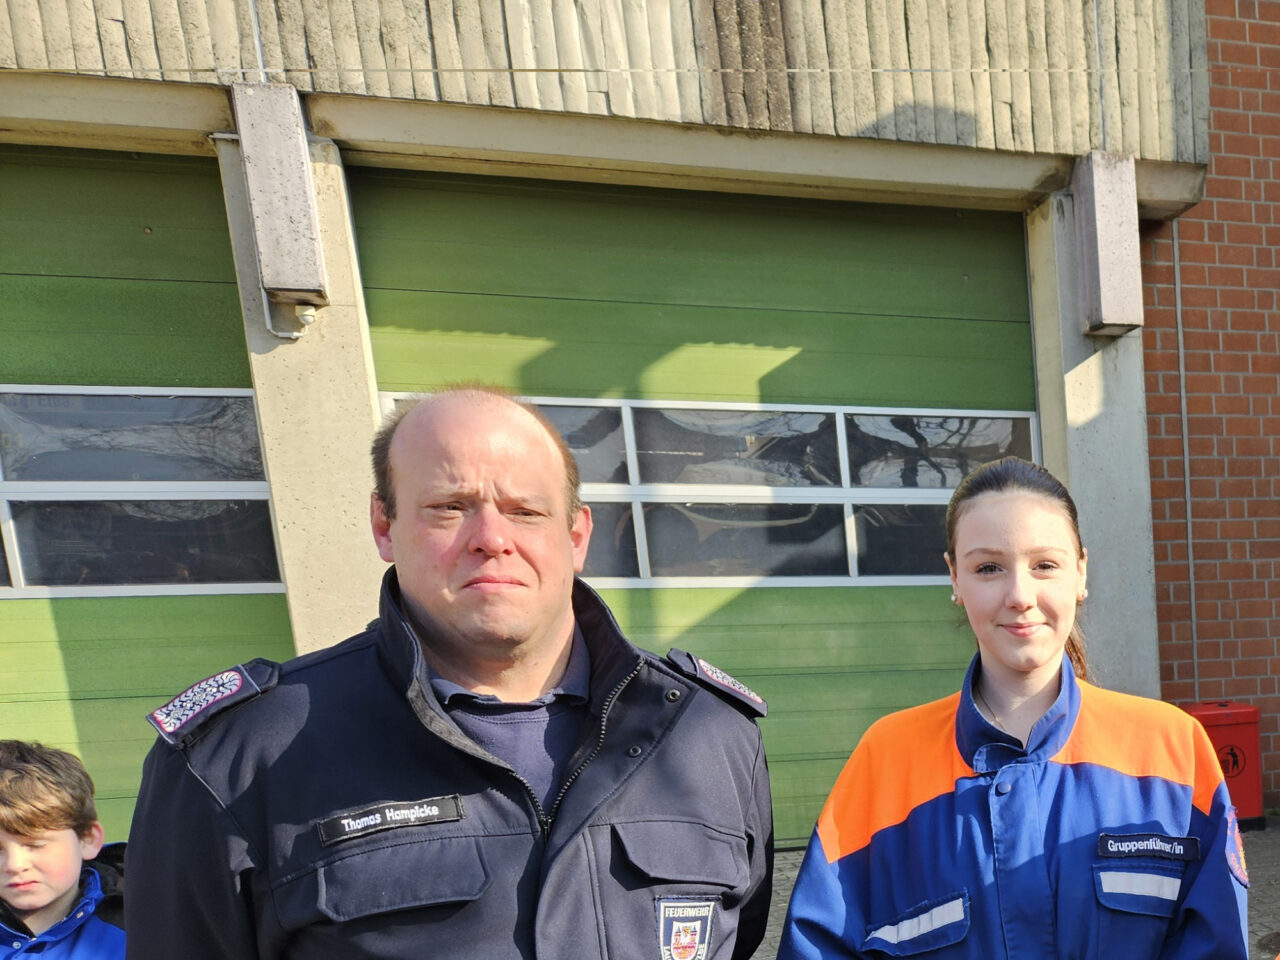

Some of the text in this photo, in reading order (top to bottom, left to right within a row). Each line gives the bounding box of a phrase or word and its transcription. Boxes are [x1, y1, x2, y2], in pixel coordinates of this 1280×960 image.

[341, 804, 439, 831] Thomas Hampicke
[665, 906, 710, 917] FEUERWEHR
